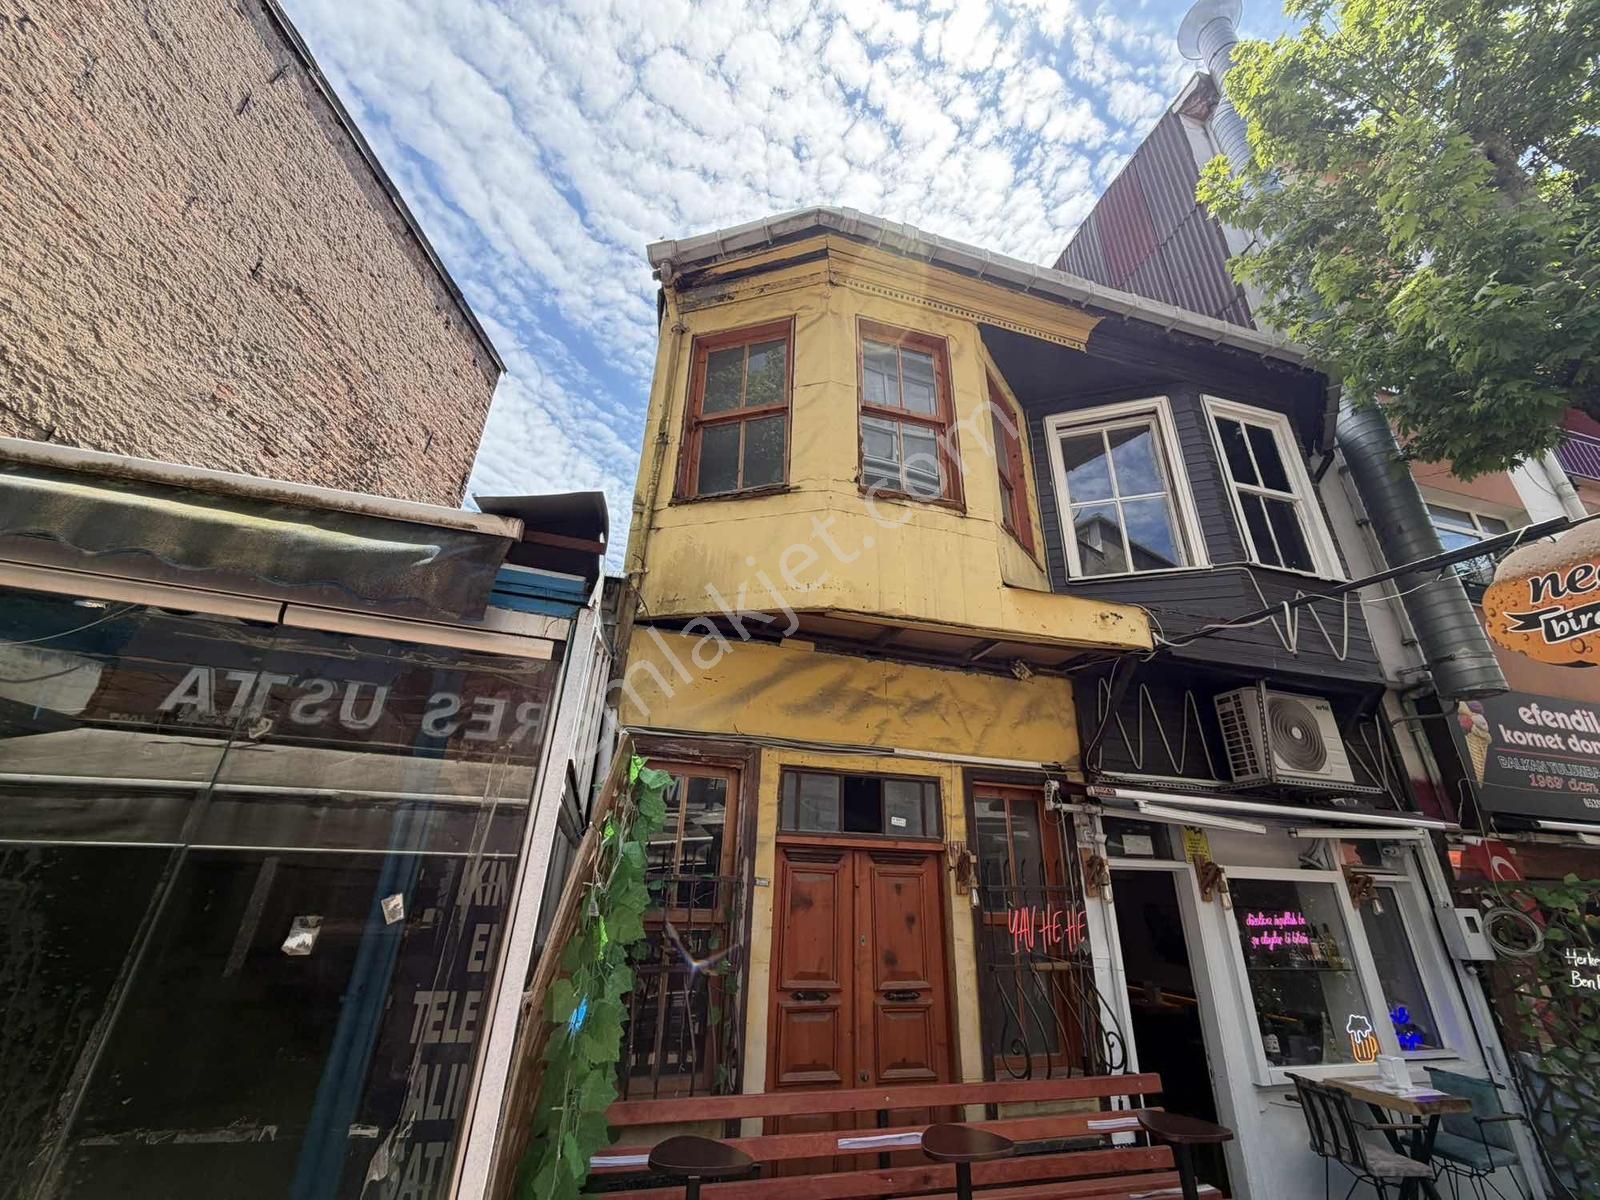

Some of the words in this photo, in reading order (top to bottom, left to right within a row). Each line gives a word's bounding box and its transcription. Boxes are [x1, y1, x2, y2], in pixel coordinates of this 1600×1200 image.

[1528, 563, 1600, 605] ne
[1498, 724, 1566, 751] kornet
[410, 991, 482, 1043] TELE
